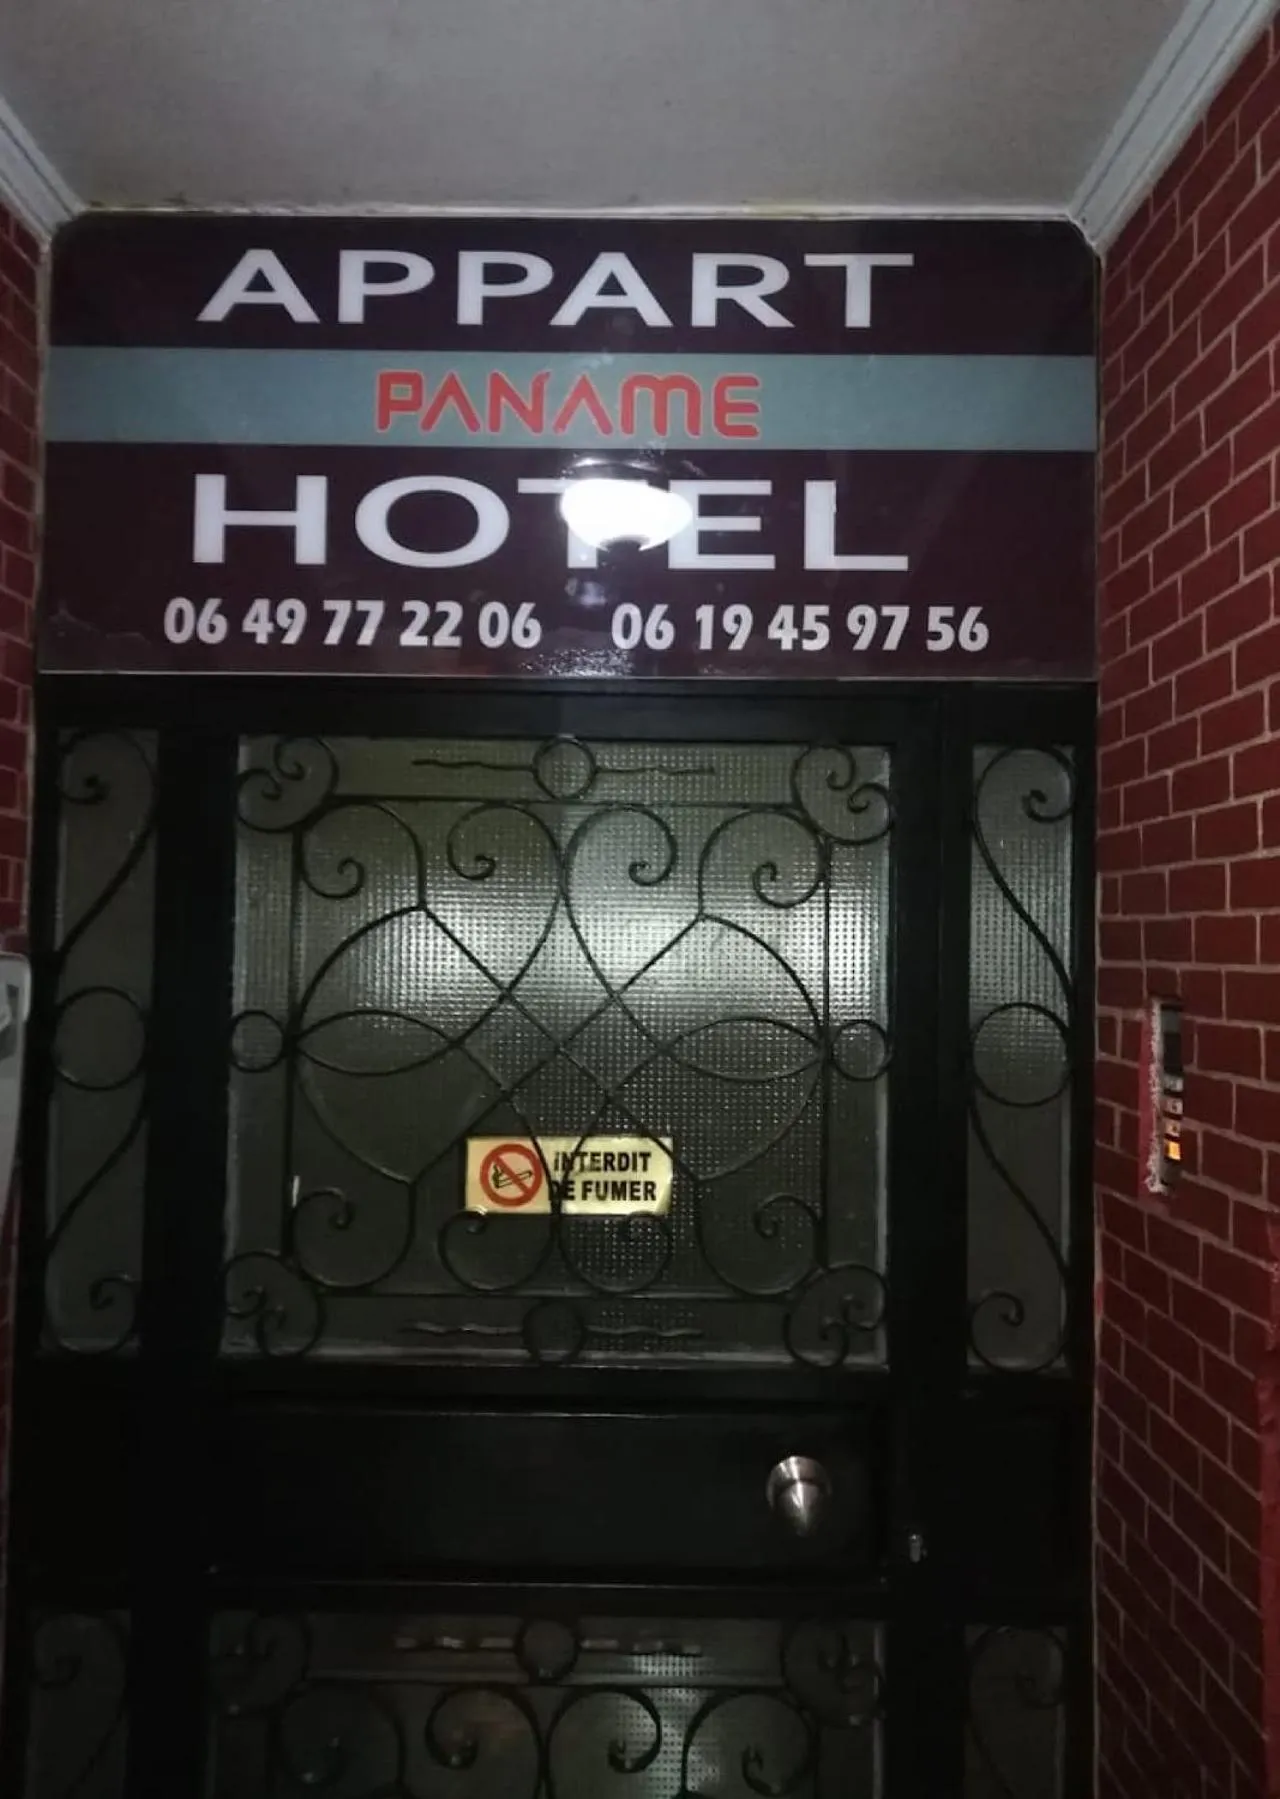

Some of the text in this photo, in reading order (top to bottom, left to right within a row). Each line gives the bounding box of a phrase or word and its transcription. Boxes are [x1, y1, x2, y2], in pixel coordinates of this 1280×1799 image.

[198, 248, 914, 328] APPART
[377, 370, 761, 438] PANAME
[164, 597, 989, 653] 06 49 77 22 06 06 19 45 97 56
[553, 1151, 652, 1172] INTERDIT
[581, 1180, 657, 1202] FUMER
